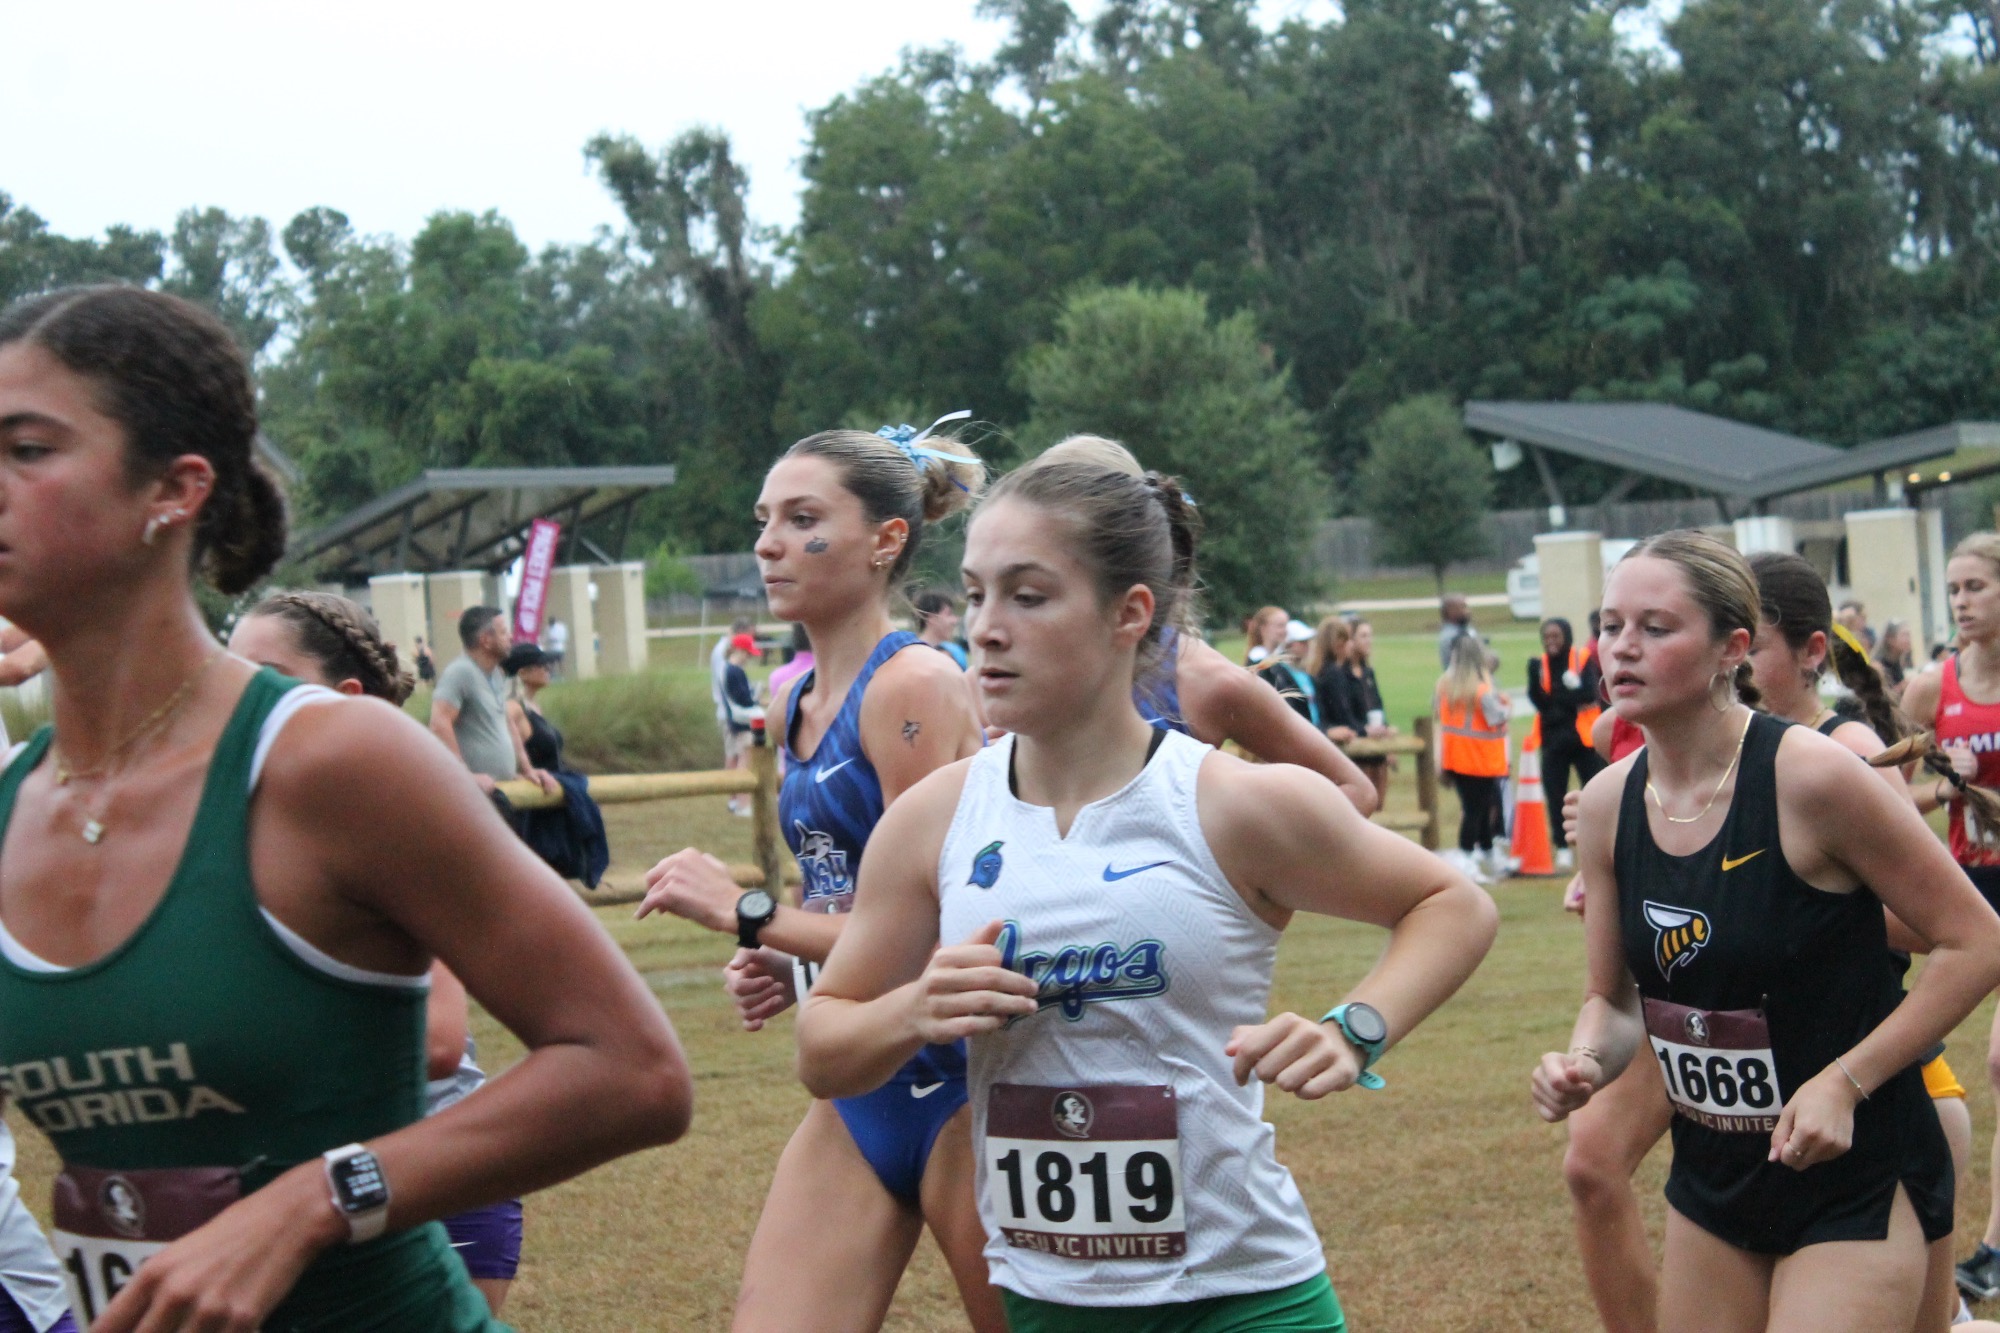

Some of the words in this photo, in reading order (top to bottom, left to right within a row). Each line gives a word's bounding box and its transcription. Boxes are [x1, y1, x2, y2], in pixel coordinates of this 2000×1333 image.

[1659, 1047, 1774, 1109] 1668
[34, 1086, 247, 1132] ORIDA
[1717, 1117, 1774, 1132] INVITE
[997, 1149, 1174, 1223] 1819
[1012, 1232, 1048, 1251] FSU
[1054, 1236, 1081, 1257] XC
[1087, 1236, 1170, 1257] INVITE
